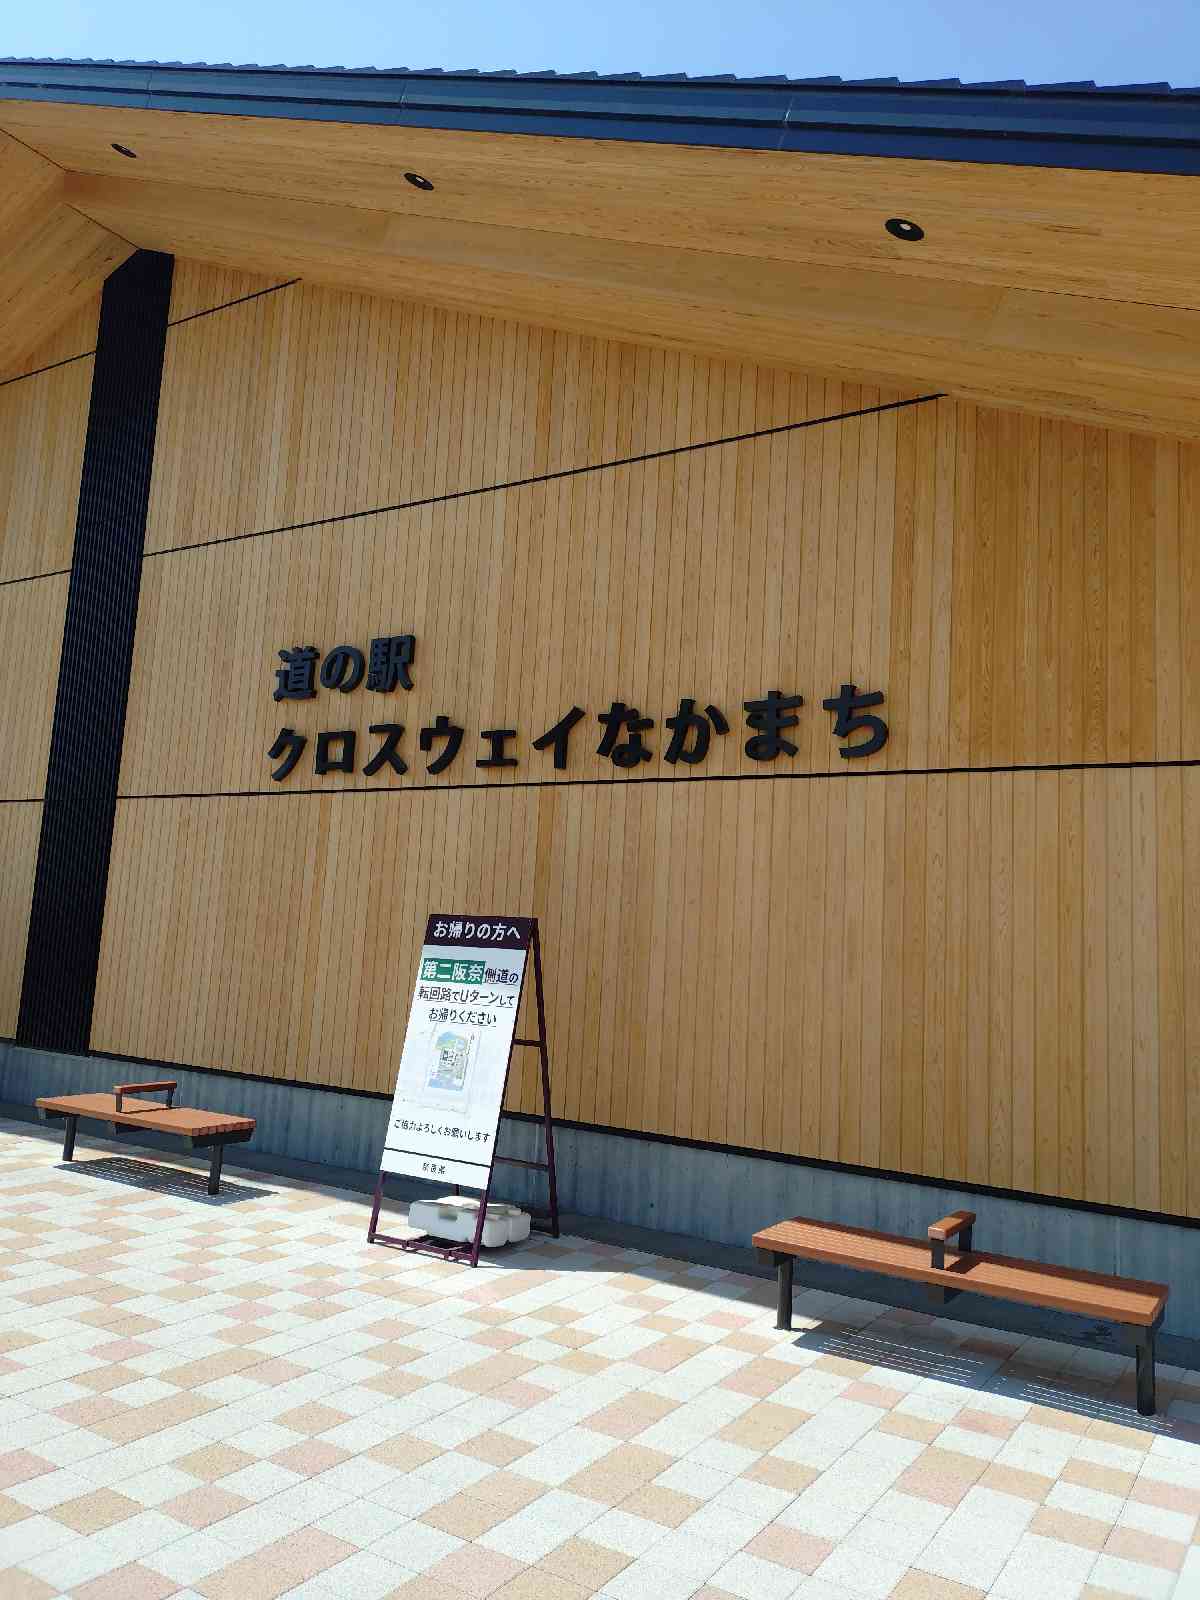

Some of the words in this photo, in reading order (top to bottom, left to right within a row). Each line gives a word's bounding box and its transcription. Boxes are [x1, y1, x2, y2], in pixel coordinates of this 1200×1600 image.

[273, 634, 415, 701] 道の駅
[268, 684, 889, 782] クロスウェイなかまち
[433, 921, 521, 941] お帰りの方へ
[428, 1007, 497, 1024] お帰りください
